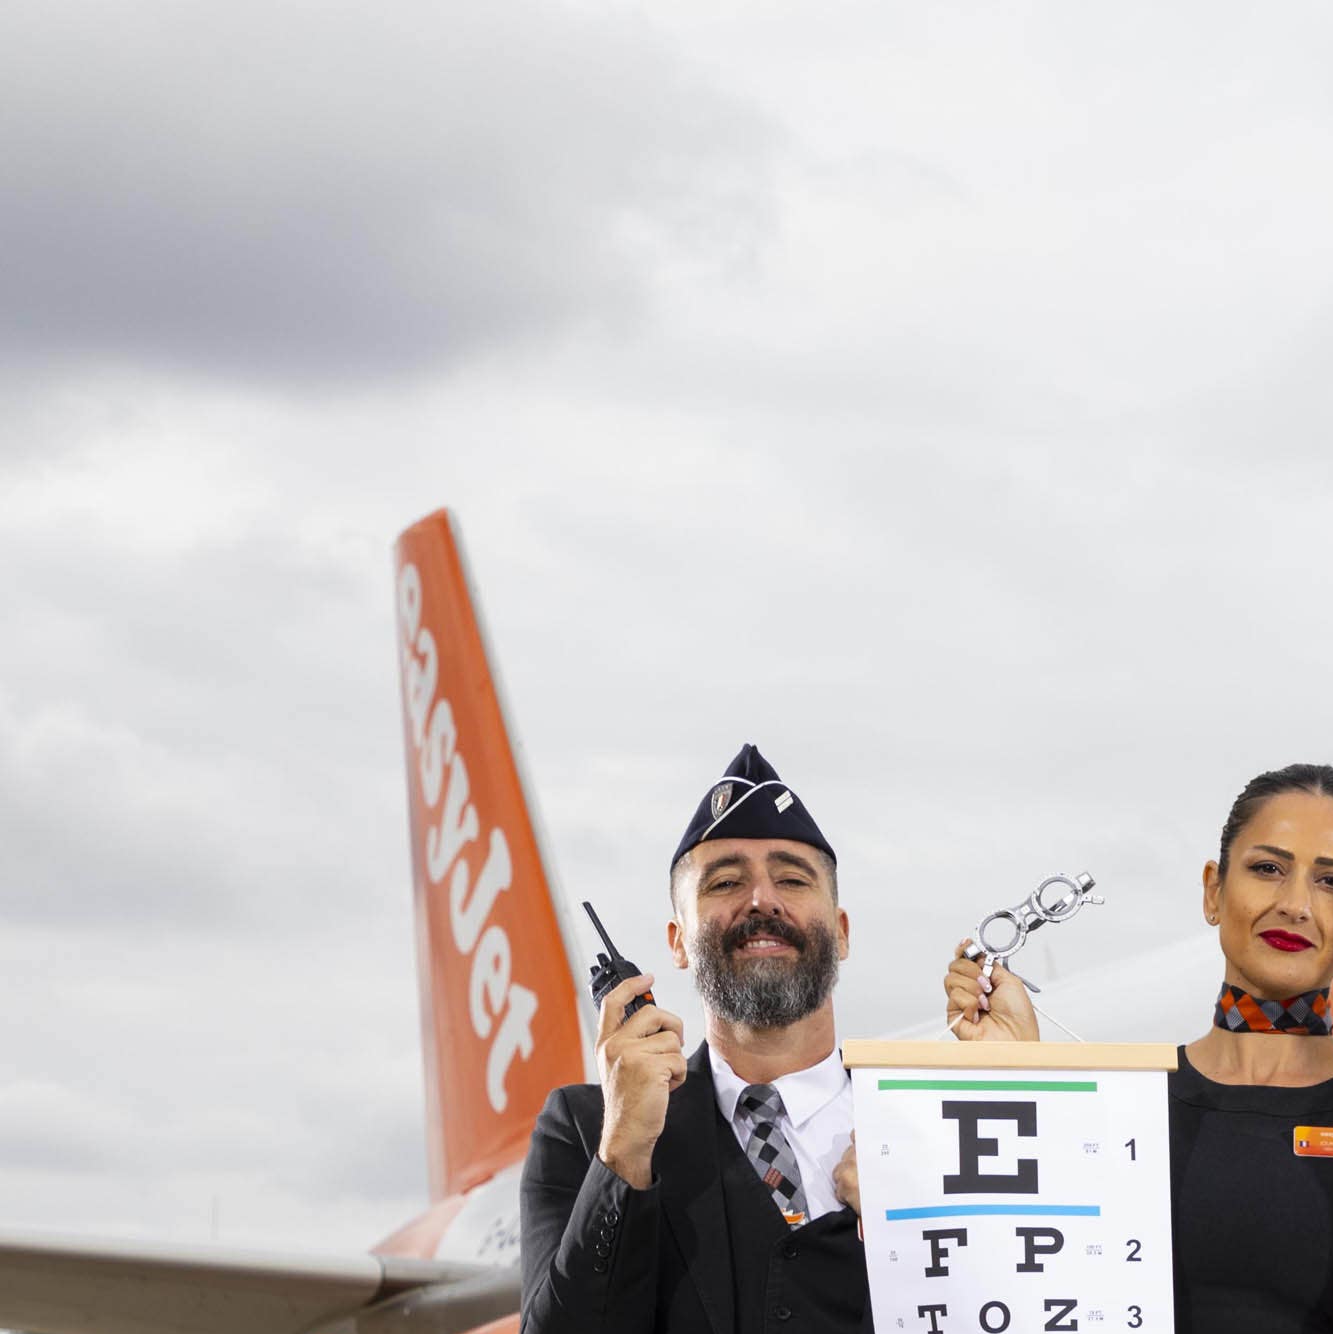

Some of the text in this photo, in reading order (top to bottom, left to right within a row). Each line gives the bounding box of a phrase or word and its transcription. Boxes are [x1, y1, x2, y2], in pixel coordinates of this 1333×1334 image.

[399, 562, 538, 1113] easyJet
[942, 1100, 1039, 1194] E
[1125, 1138, 1136, 1161] 1
[1126, 1239, 1142, 1262] 2
[1127, 1305, 1143, 1328] 3
